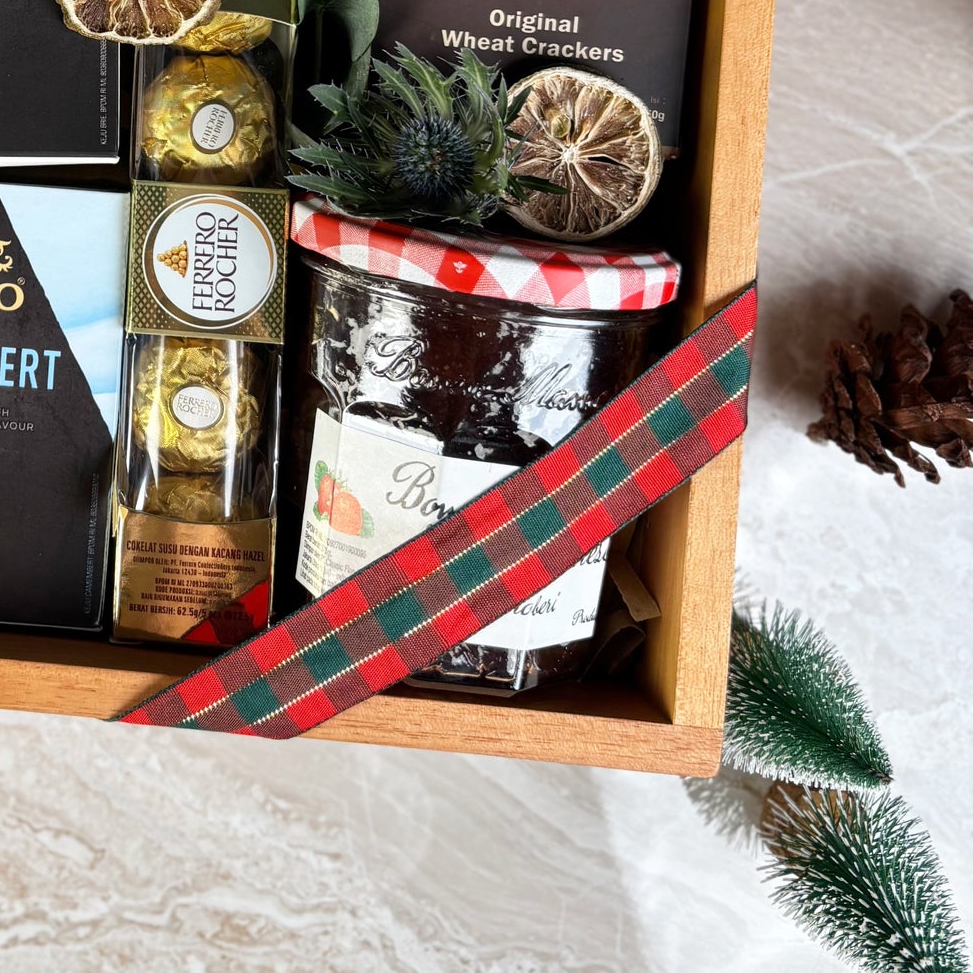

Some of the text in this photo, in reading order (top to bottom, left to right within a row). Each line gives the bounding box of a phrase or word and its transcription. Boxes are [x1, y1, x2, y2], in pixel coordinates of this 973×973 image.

[489, 9, 579, 34] Original
[441, 29, 624, 63] Wheat Crackers
[648, 109, 665, 123] 0g
[192, 211, 217, 312] FERRERO
[214, 212, 240, 313] ROCHER
[126, 540, 265, 562] COKELAT SUSU DENGAN KACANG HAZEL
